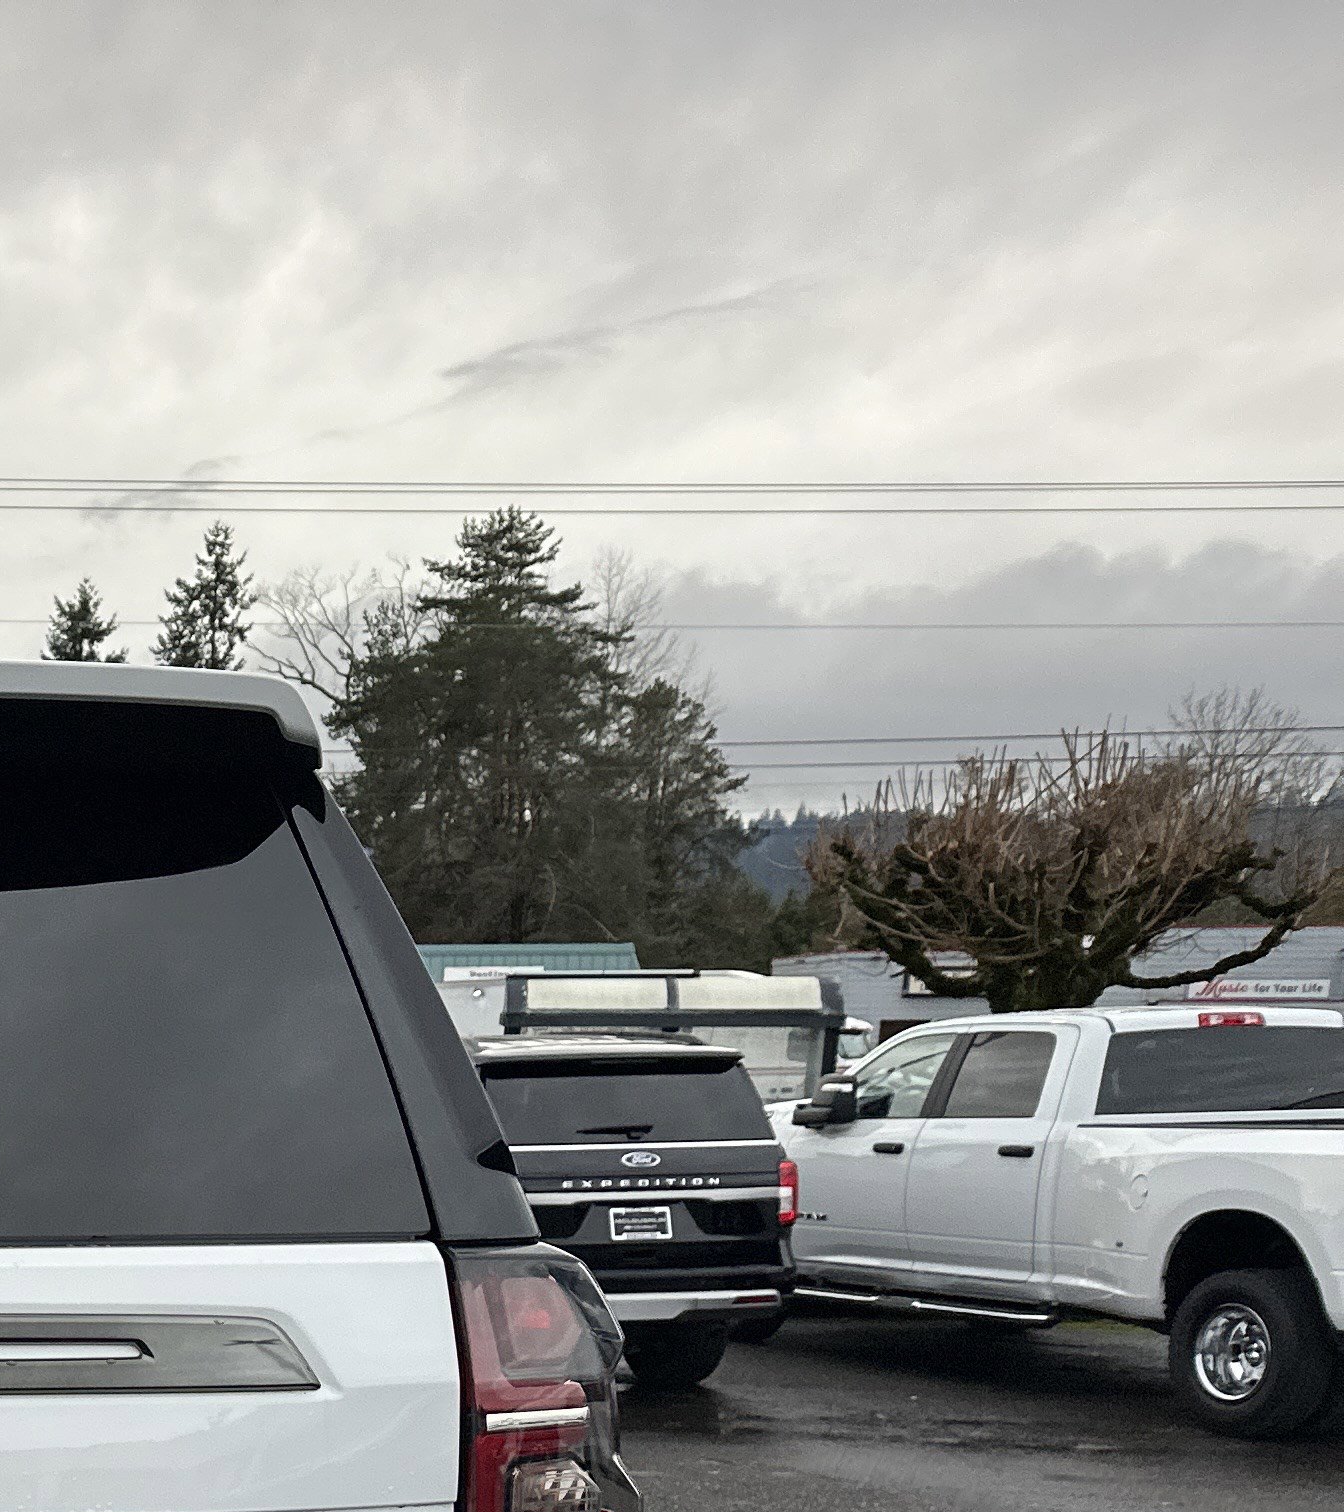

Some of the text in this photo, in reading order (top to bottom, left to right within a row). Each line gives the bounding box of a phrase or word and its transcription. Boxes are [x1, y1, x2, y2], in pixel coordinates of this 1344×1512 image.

[1196, 976, 1324, 998] Music for Your Life
[562, 1177, 721, 1188] EXPEDITION
